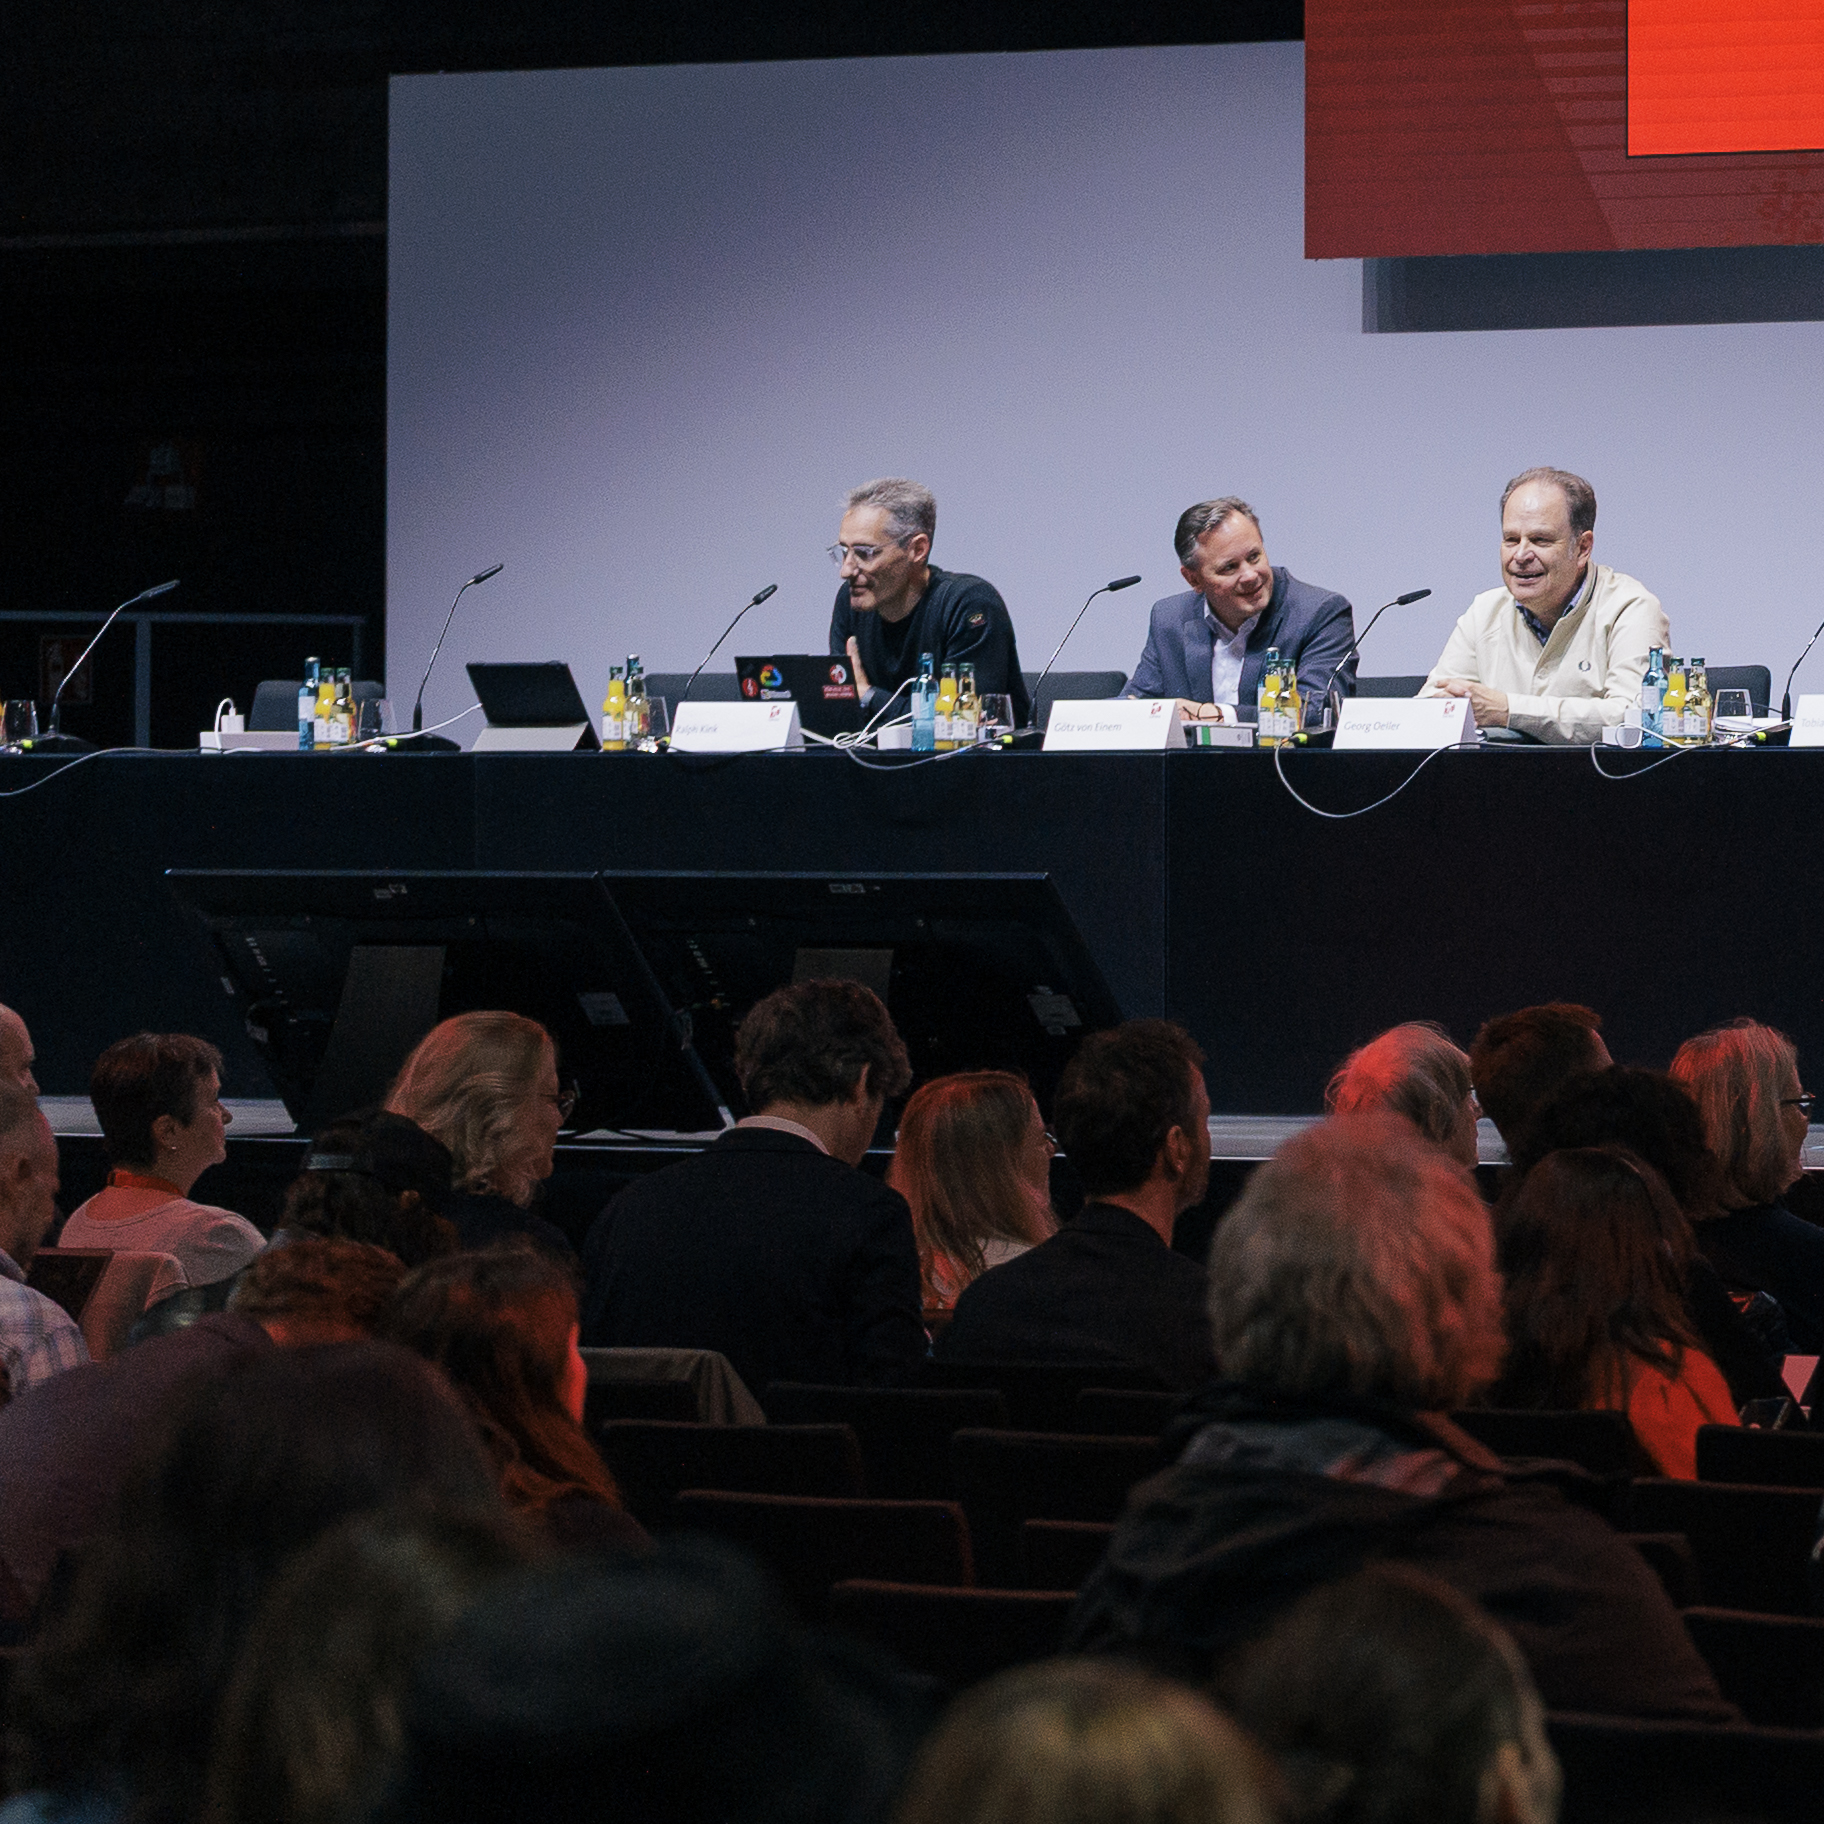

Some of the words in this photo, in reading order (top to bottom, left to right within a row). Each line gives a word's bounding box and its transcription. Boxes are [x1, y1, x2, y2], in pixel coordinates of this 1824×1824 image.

[1054, 722, 1076, 732] Götz
[1076, 724, 1093, 732] von
[1093, 721, 1122, 732] Einem
[1343, 721, 1372, 733] Georg
